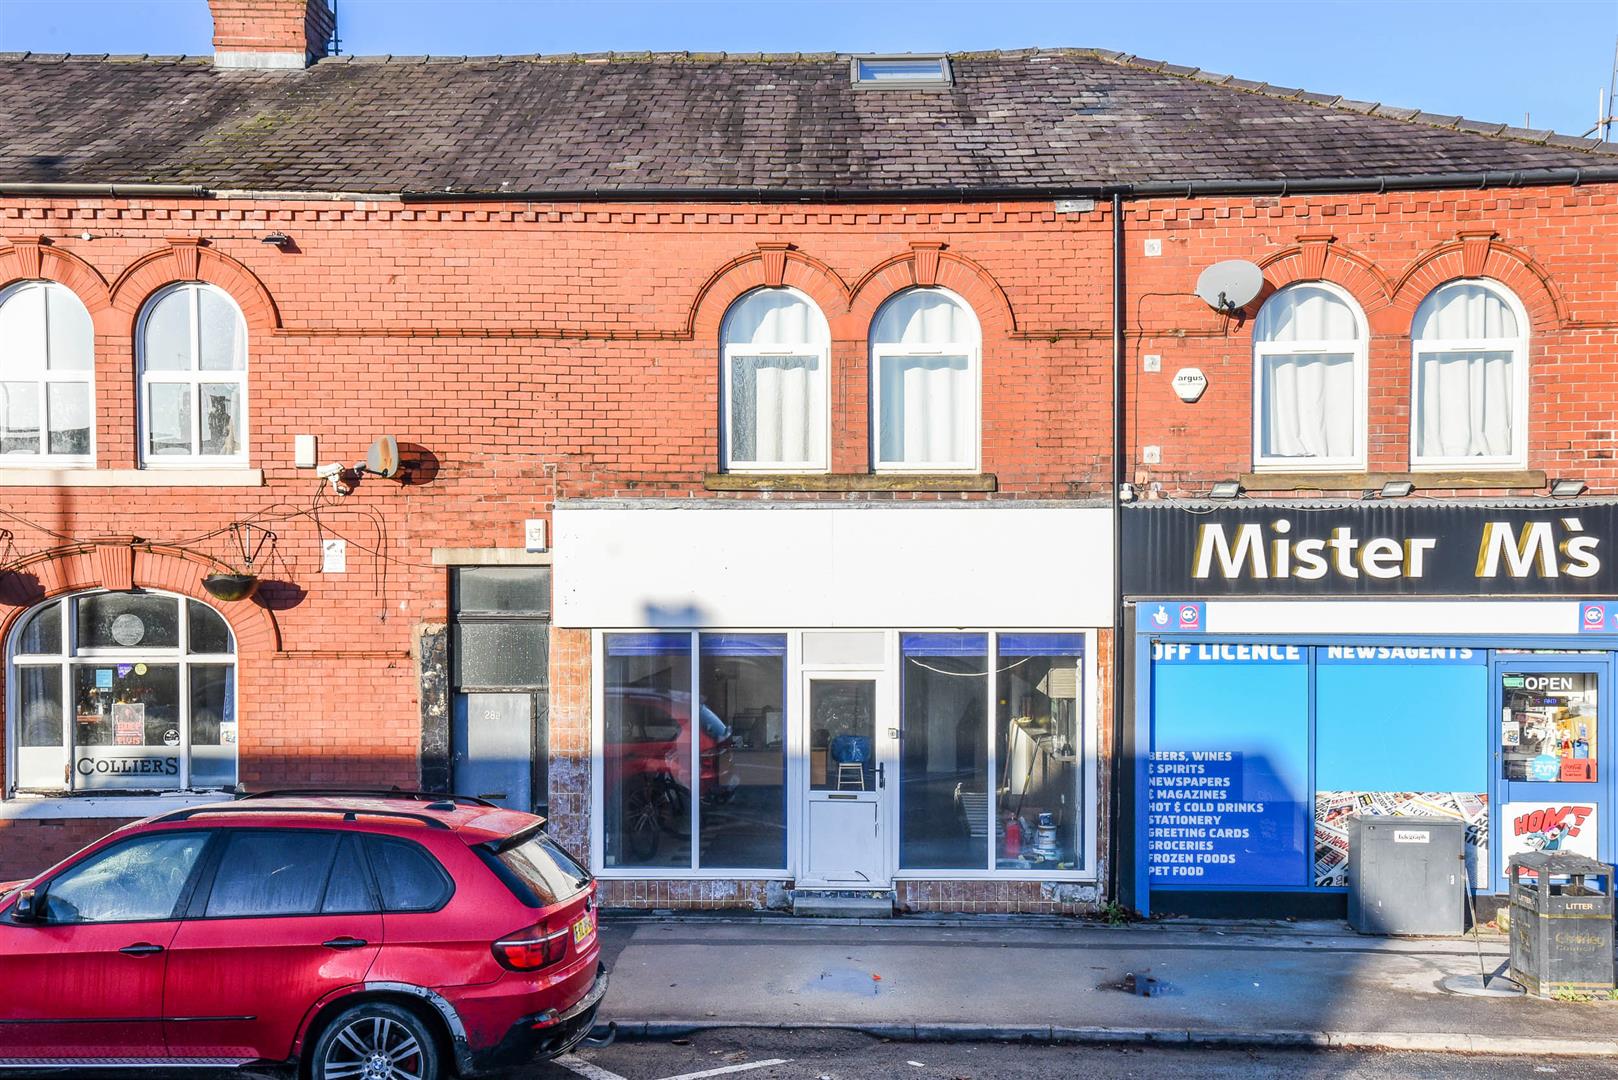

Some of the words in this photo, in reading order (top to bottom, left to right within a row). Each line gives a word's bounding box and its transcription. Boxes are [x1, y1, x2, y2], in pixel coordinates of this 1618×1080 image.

[1177, 375, 1204, 383] argus
[1192, 518, 1437, 580] Mister
[1150, 644, 1191, 661] OFF
[1199, 644, 1300, 661] LICENCE
[1327, 646, 1474, 660] NEWSAGENTS
[1524, 677, 1573, 690] OPEN
[1149, 751, 1189, 762] BEERS,
[1192, 751, 1232, 762] WINES
[1157, 764, 1205, 774] SPIRITS
[1149, 776, 1231, 787] NEWSPAPERS
[1157, 789, 1227, 800] MAGAZINES
[1149, 802, 1171, 812] HOT
[1174, 802, 1182, 813] &
[1184, 802, 1214, 812] COLD
[1217, 803, 1264, 813] DRINKS
[1149, 815, 1222, 825] STATIONERY
[1514, 806, 1593, 837] HOME
[1149, 828, 1206, 838] GREETING
[1209, 828, 1250, 838] CARDS
[1149, 840, 1214, 851] GROCERIES
[1149, 853, 1194, 864] FROZEN
[1196, 853, 1236, 864] FOODS
[1149, 866, 1170, 876] PET
[1172, 866, 1204, 876] FOOD
